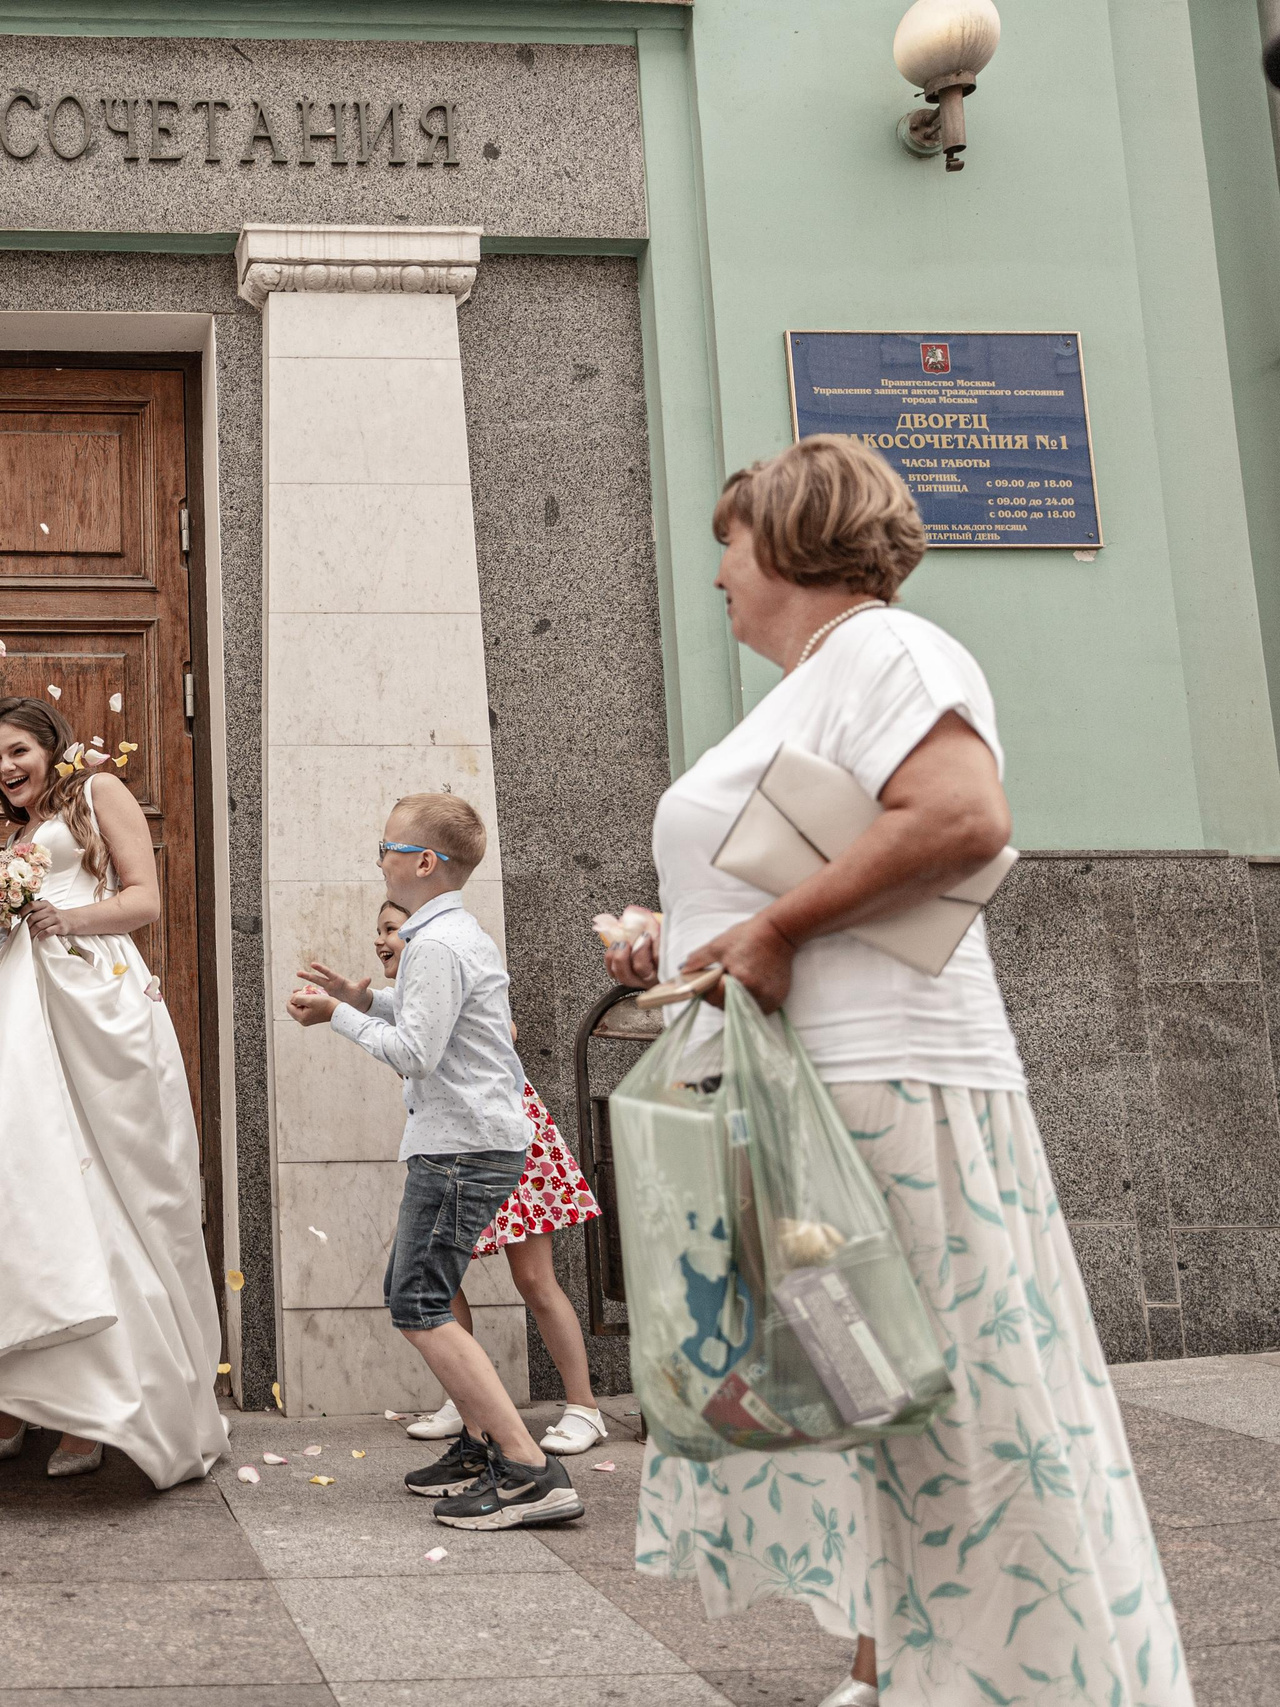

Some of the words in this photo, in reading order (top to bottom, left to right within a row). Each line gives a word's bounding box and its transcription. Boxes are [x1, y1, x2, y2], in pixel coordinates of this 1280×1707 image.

[881, 378, 954, 388] Правительство
[956, 379, 996, 387] Москвы
[813, 387, 872, 396] Управление
[911, 388, 940, 396] актов
[942, 388, 1011, 397] гражданского
[902, 397, 937, 405] города
[939, 396, 978, 404] Москвы
[895, 413, 990, 432] ДВОРЕЦ
[824, 433, 1029, 449] КОСОЧЕТАНИЯ
[901, 458, 938, 468] ЧАСЫ
[941, 458, 991, 468] РАБОТЫ
[908, 473, 961, 482] ВТОРНИК,
[918, 484, 969, 493] ПЯТНИЦА
[995, 479, 1025, 487] 09.00
[1026, 480, 1041, 489] до
[1044, 479, 1073, 488] 18.00
[996, 497, 1027, 505] 09.00
[1028, 498, 1043, 507] до
[1045, 497, 1075, 505] 24.00
[998, 510, 1028, 518] 00.00
[1029, 511, 1044, 519] до
[1046, 510, 1076, 518] 18.00
[925, 531, 972, 540] ИТАРНЫЙ
[973, 532, 1001, 541] ДЕНЬ
